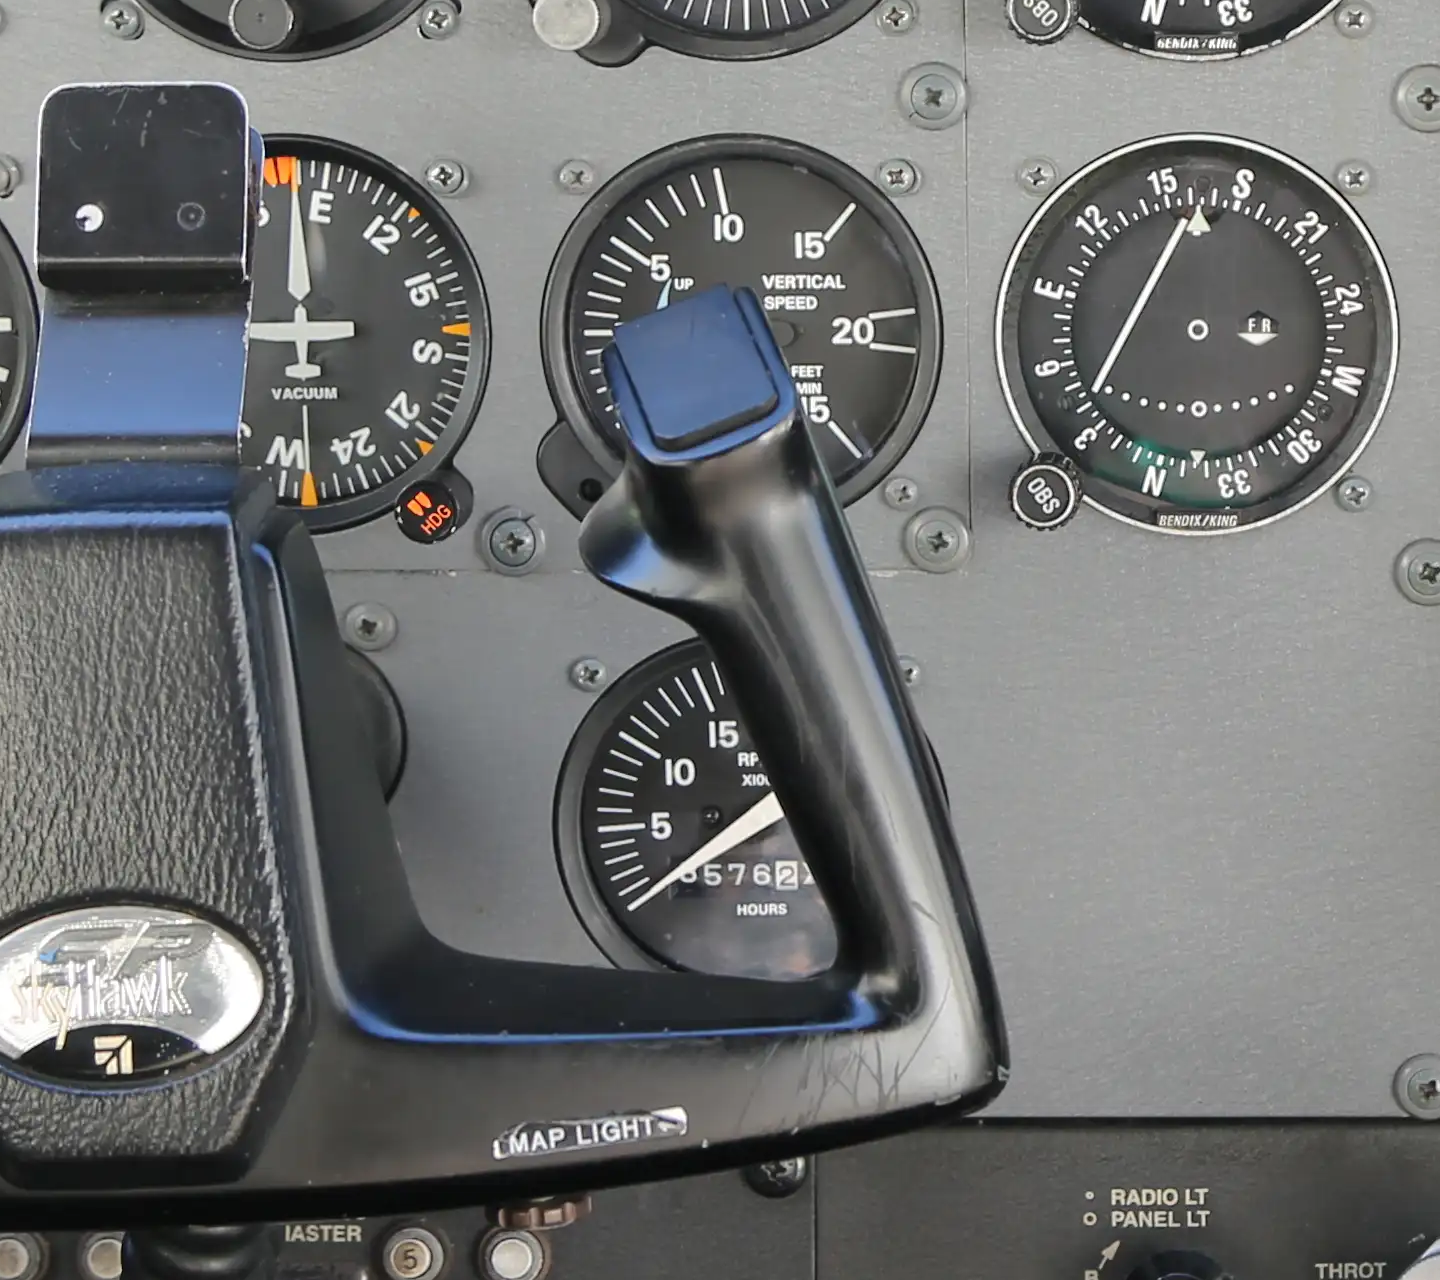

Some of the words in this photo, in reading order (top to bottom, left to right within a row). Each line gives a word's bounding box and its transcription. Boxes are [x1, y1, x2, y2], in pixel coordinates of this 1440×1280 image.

[761, 274, 846, 290] VERTICAL
[763, 295, 818, 311] SPEED
[1158, 514, 1238, 527] BENDIX/KING
[736, 903, 788, 916] HOURS
[508, 1124, 568, 1156] MAP
[574, 1115, 654, 1146] LIGHT
[1110, 1188, 1179, 1206] RADIO
[1184, 1187, 1209, 1206] LT
[1111, 1210, 1181, 1228] PANEL
[1186, 1210, 1211, 1228] LT
[1314, 1261, 1387, 1280] THROT
